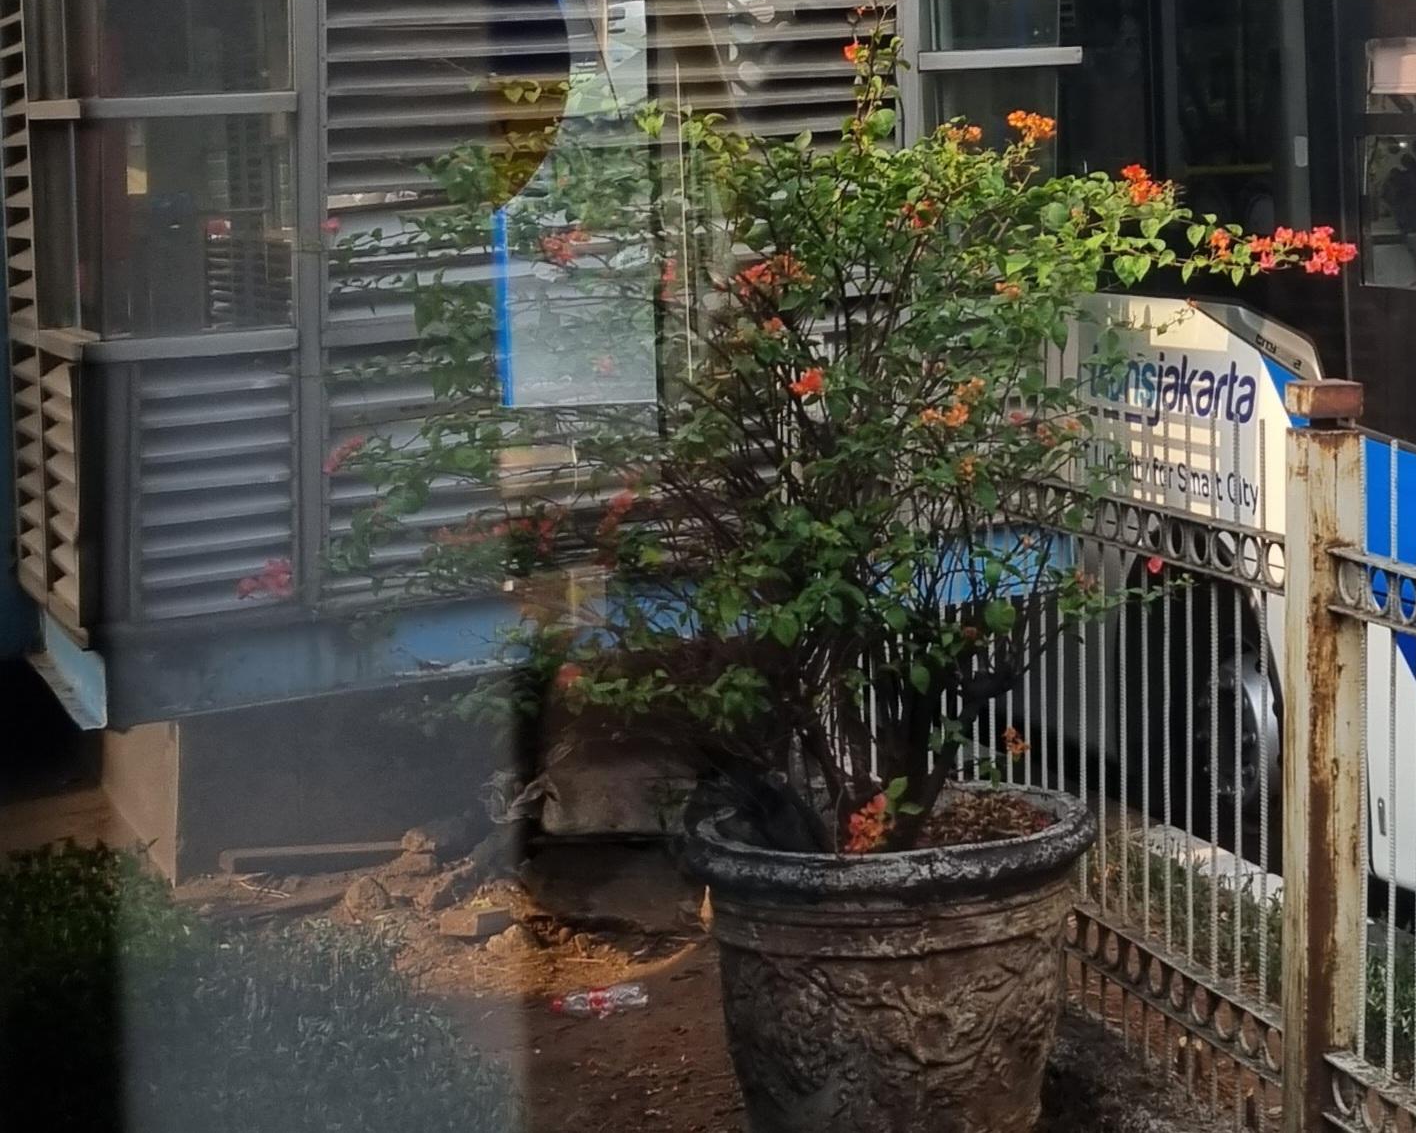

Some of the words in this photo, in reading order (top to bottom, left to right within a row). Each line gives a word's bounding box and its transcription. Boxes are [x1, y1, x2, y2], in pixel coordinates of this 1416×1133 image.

[1088, 344, 1257, 426] tnsjakarta
[1177, 462, 1223, 501] Smat
[1227, 472, 1258, 515] City
